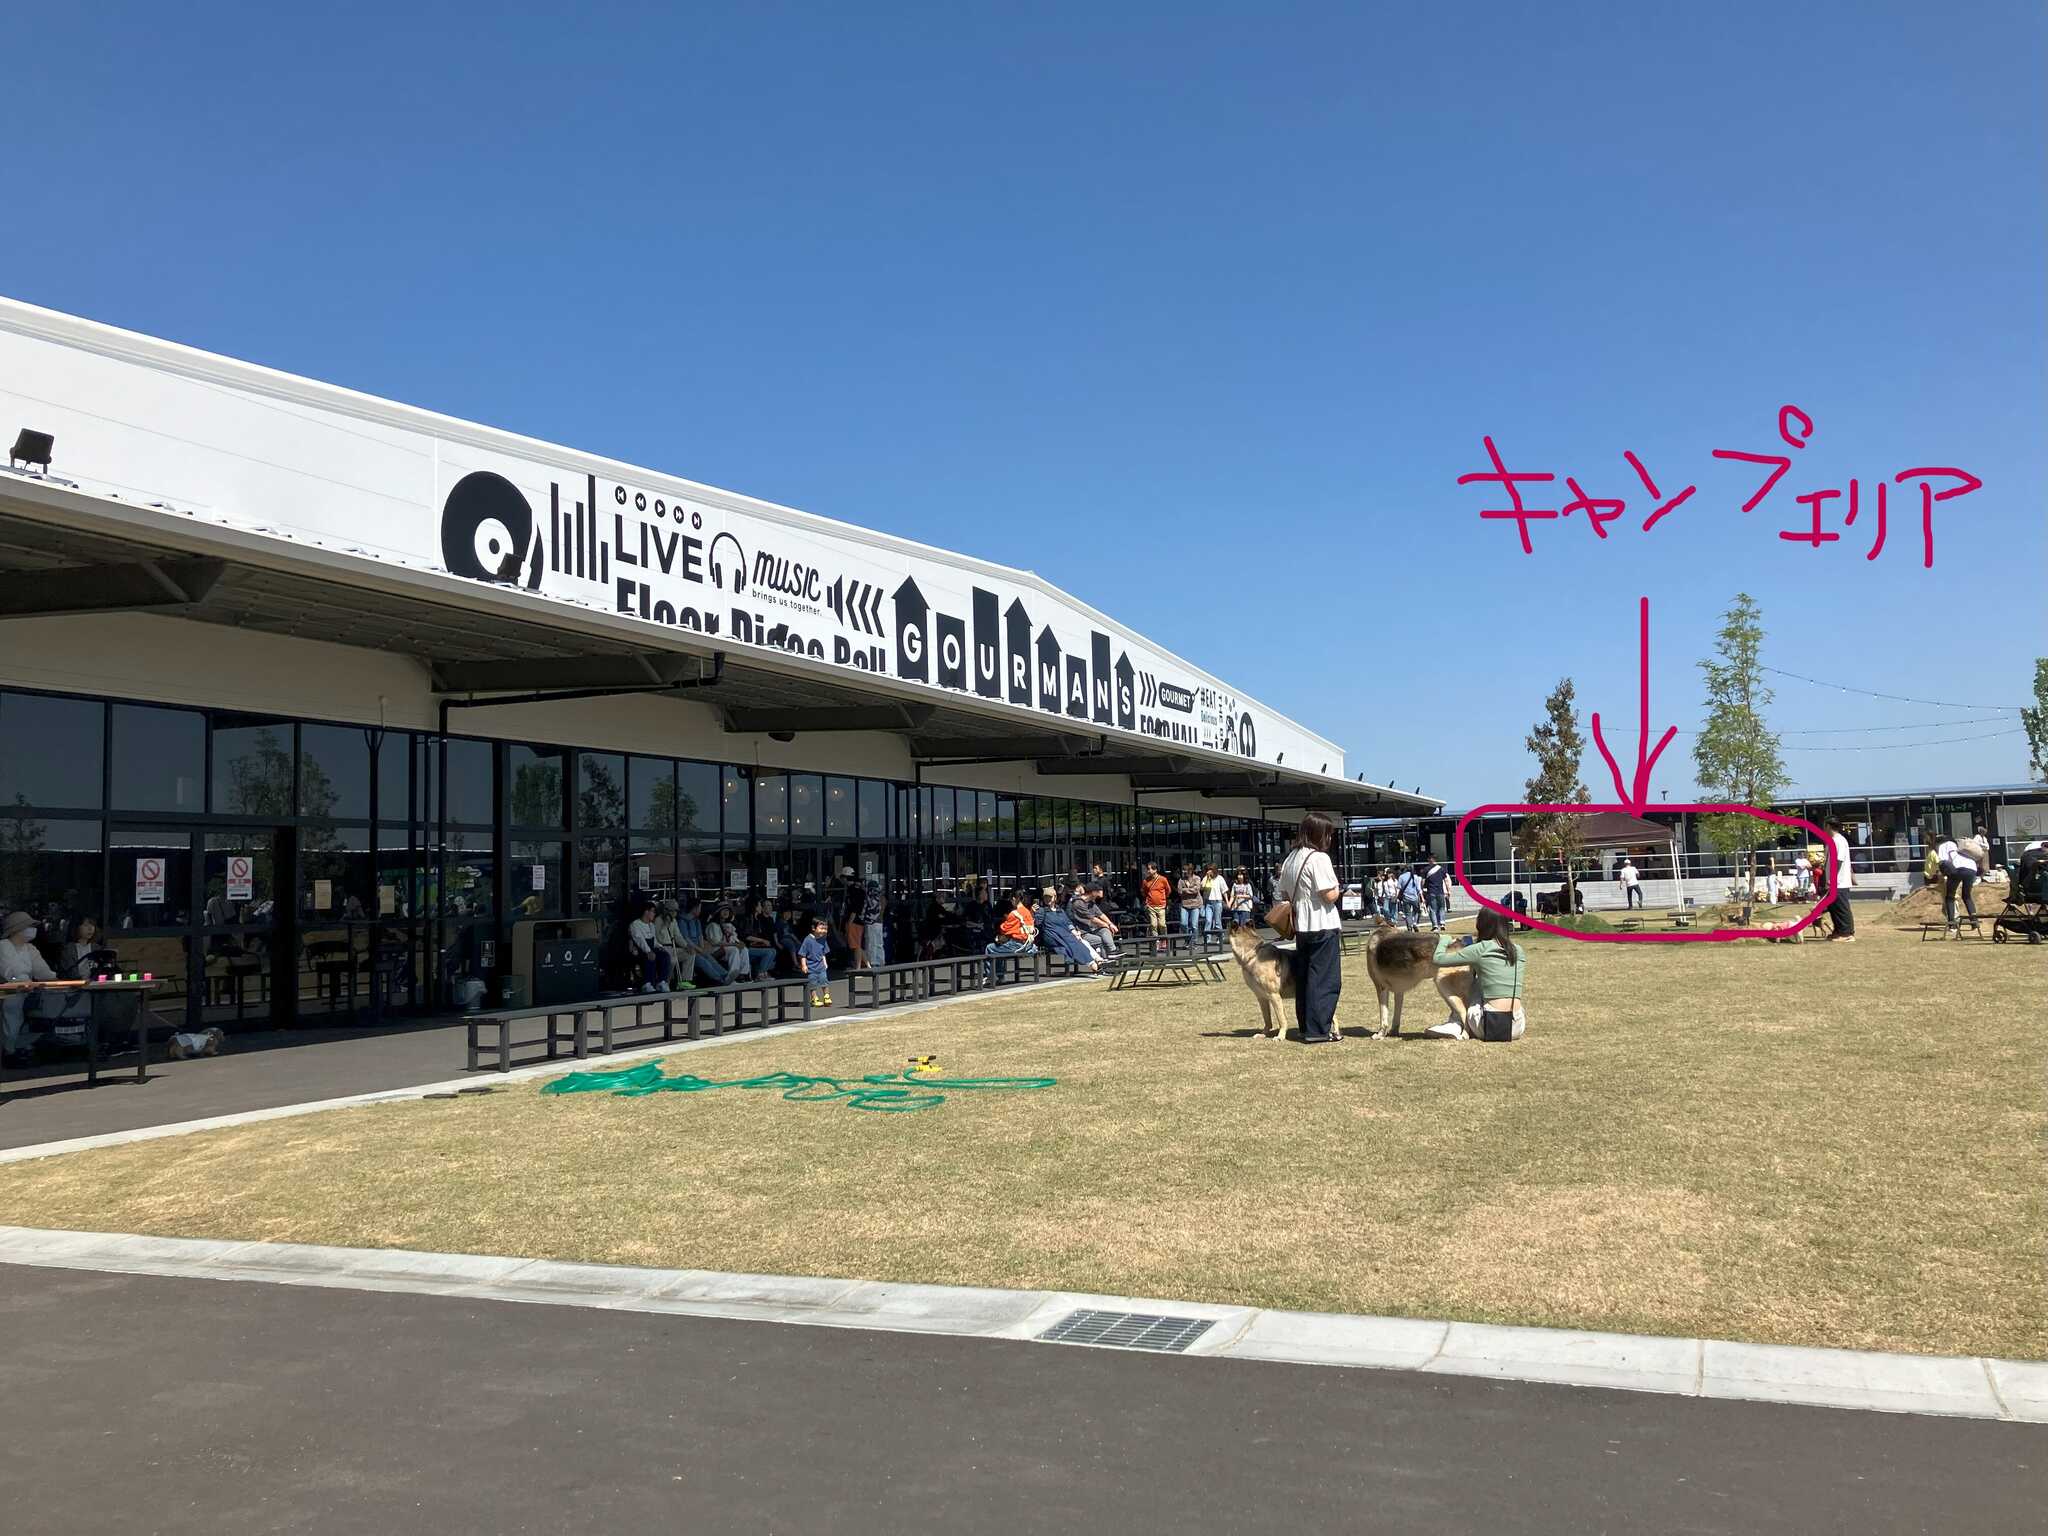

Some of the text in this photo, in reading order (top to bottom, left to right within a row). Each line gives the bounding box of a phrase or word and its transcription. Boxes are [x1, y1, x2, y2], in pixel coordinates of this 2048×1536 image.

[615, 513, 703, 584] LIVE
[752, 588, 823, 617] brings us together.
[903, 622, 1131, 716] GOURMAN'S
[1161, 687, 1191, 709] GOURMET
